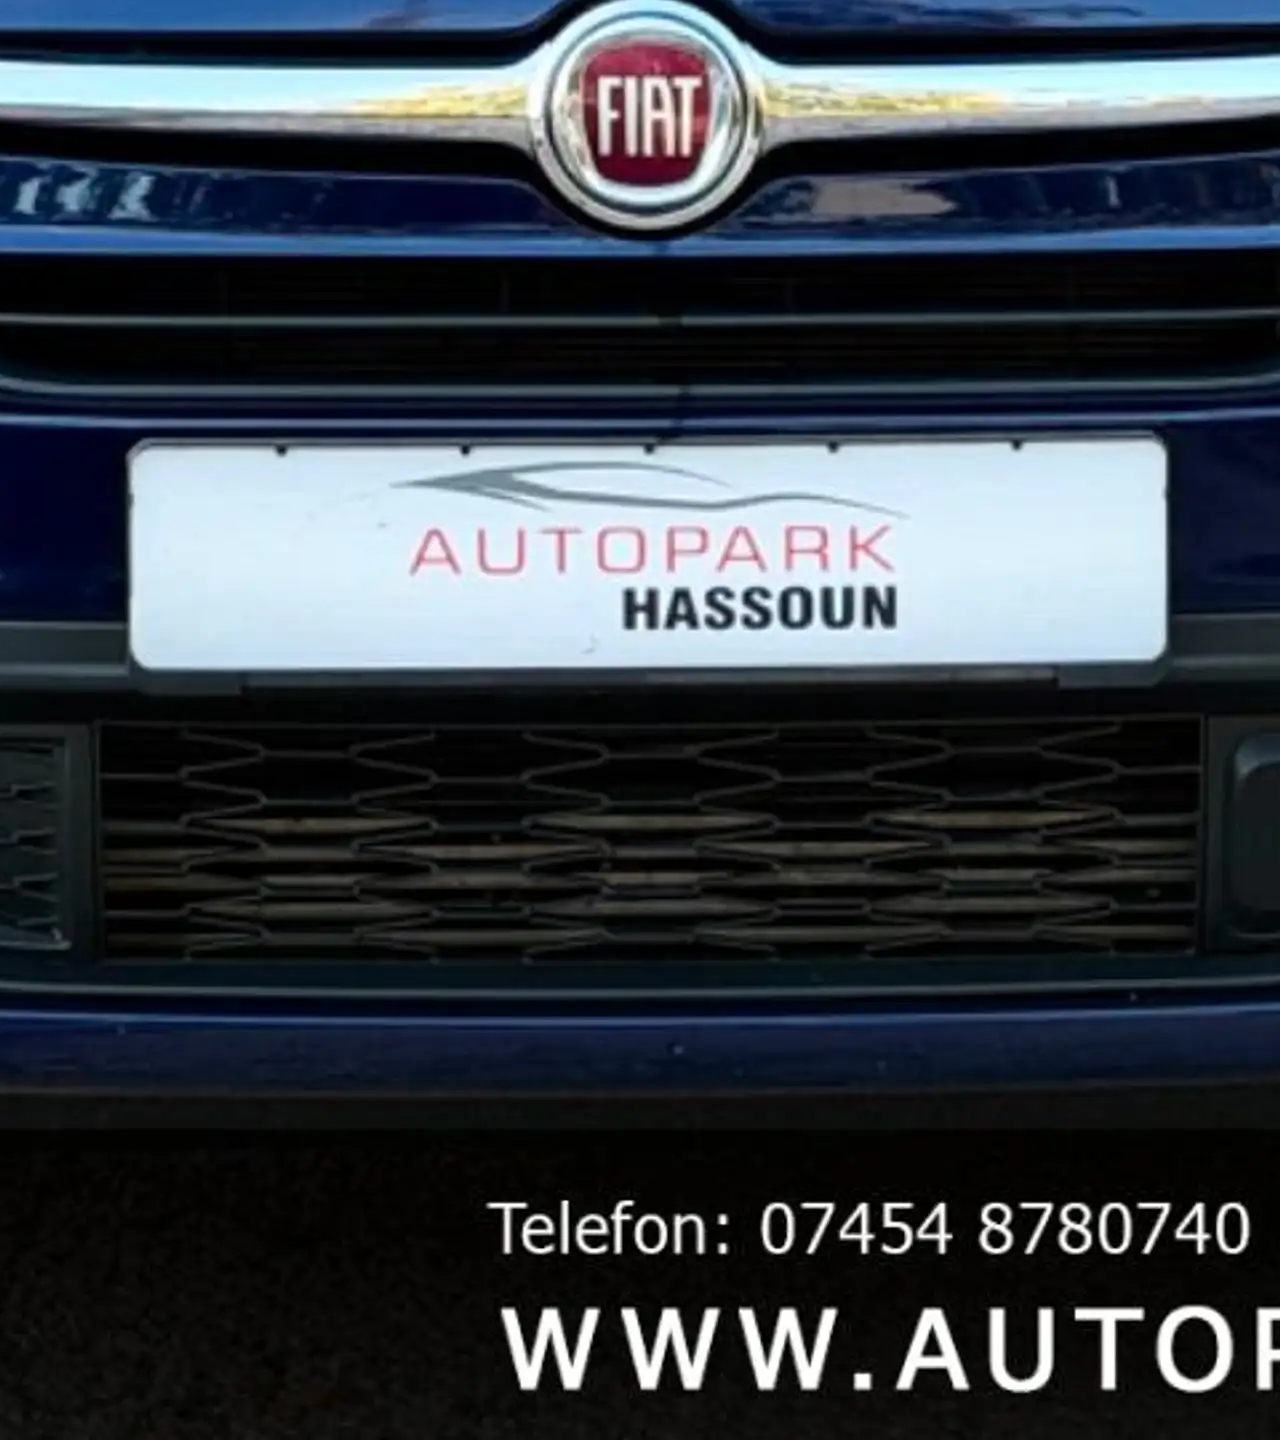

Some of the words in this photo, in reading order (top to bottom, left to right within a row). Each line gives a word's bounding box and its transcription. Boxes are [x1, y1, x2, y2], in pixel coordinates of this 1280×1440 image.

[597, 75, 703, 158] FIAT
[410, 526, 894, 575] AUTOPARK
[623, 586, 897, 630] HASSOUN
